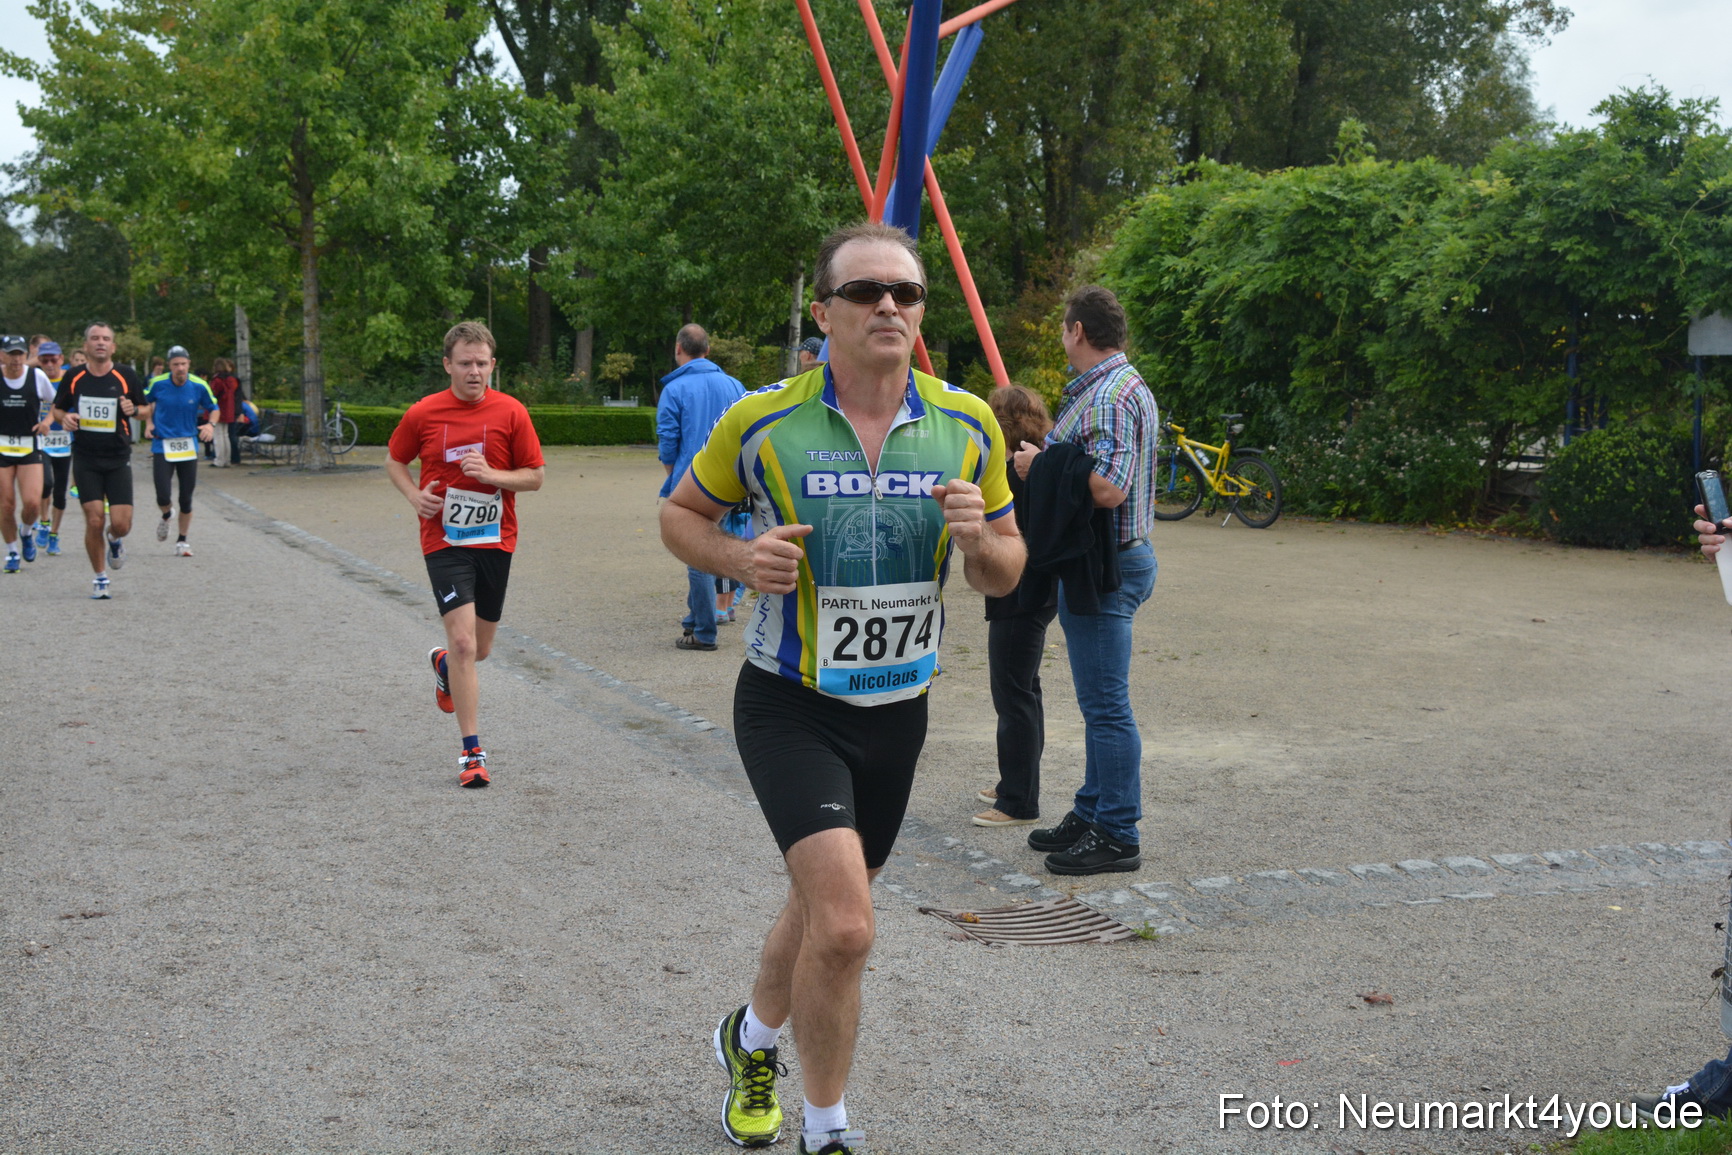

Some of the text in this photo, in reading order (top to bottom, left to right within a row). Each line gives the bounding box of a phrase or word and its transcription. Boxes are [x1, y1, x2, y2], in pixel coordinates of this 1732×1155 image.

[86, 405, 109, 419] 169
[806, 450, 862, 461] TEAM
[801, 470, 944, 499] BOCK
[447, 493, 467, 502] PARTL
[449, 503, 498, 525] 2790
[456, 528, 485, 538] Thomas
[821, 595, 931, 610] PARTL Neumarkt
[832, 609, 934, 661] 2874
[848, 669, 918, 691] Nicolaus
